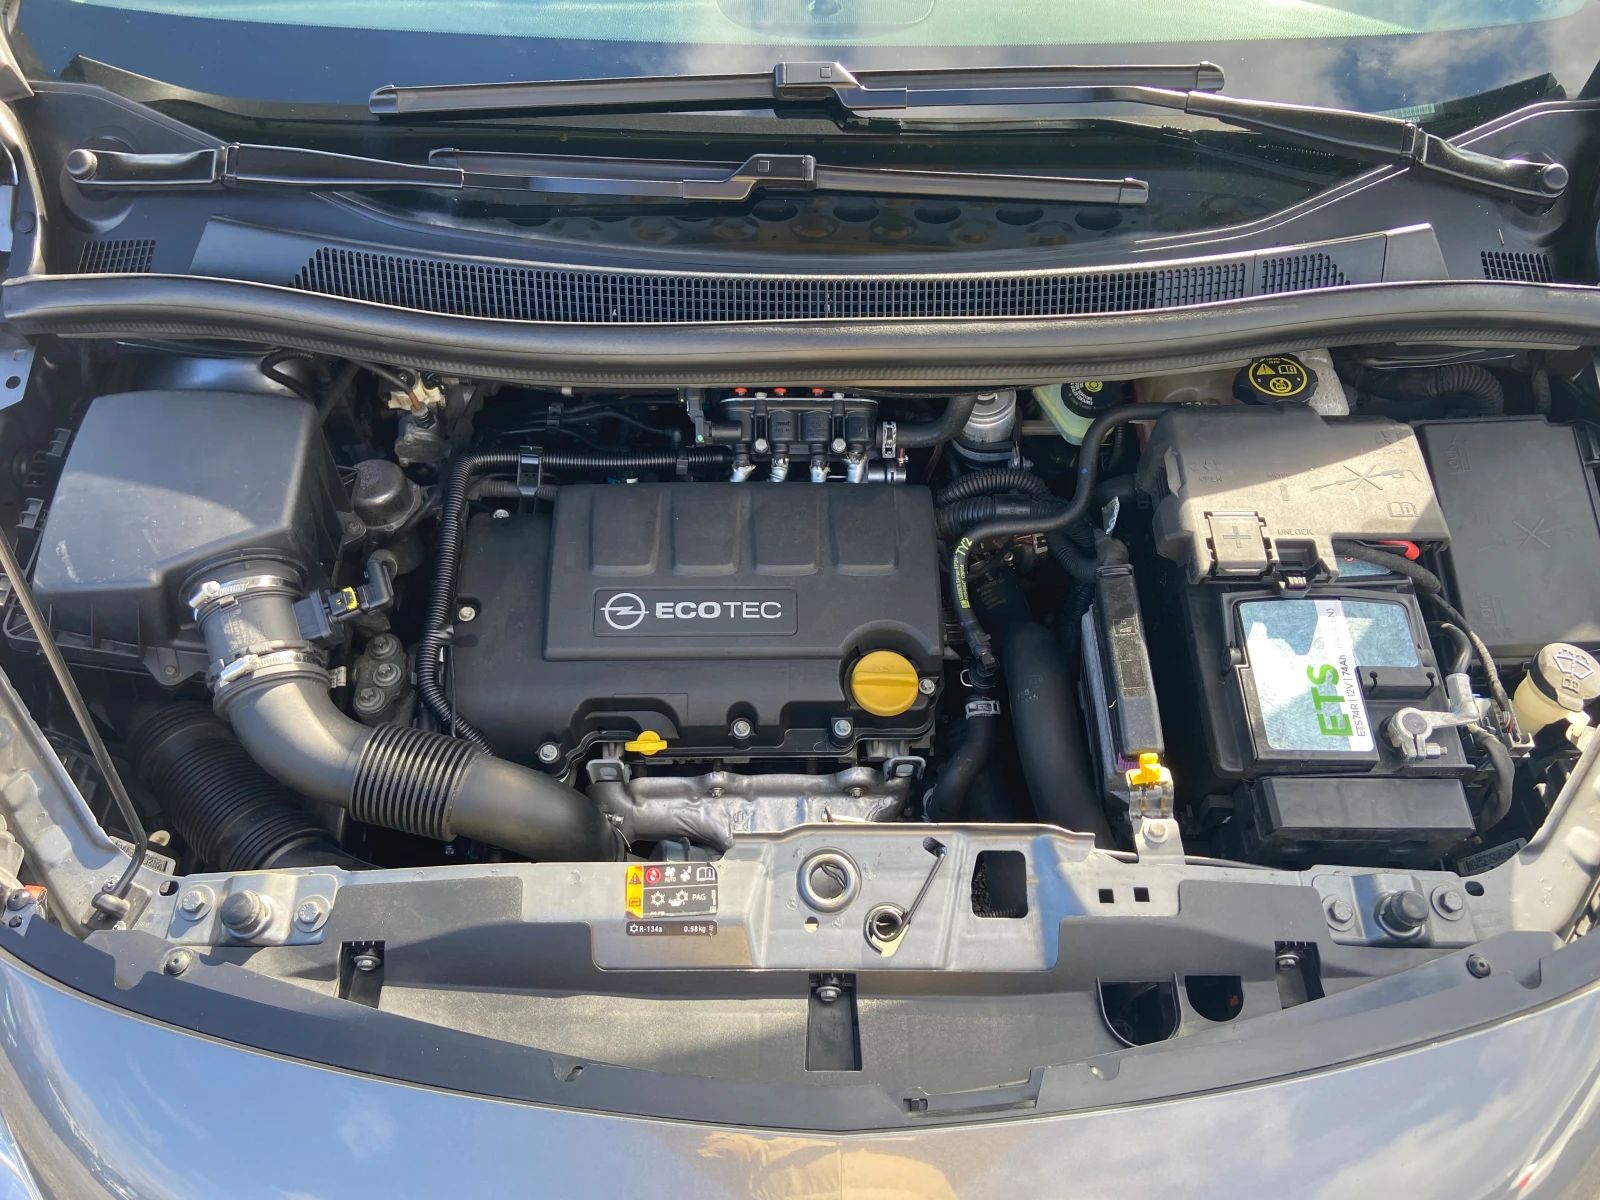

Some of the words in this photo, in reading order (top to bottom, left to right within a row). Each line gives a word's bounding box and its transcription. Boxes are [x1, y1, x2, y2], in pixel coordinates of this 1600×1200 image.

[1445, 443, 1461, 475] LOCK
[1277, 528, 1314, 536] UNLOCK
[955, 537, 972, 555] TY2
[655, 601, 782, 619] ECOTEC
[1338, 654, 1348, 677] 74Ah
[1307, 663, 1353, 736] ETS
[1350, 703, 1366, 737] ETS74R
[692, 893, 706, 901] PAG
